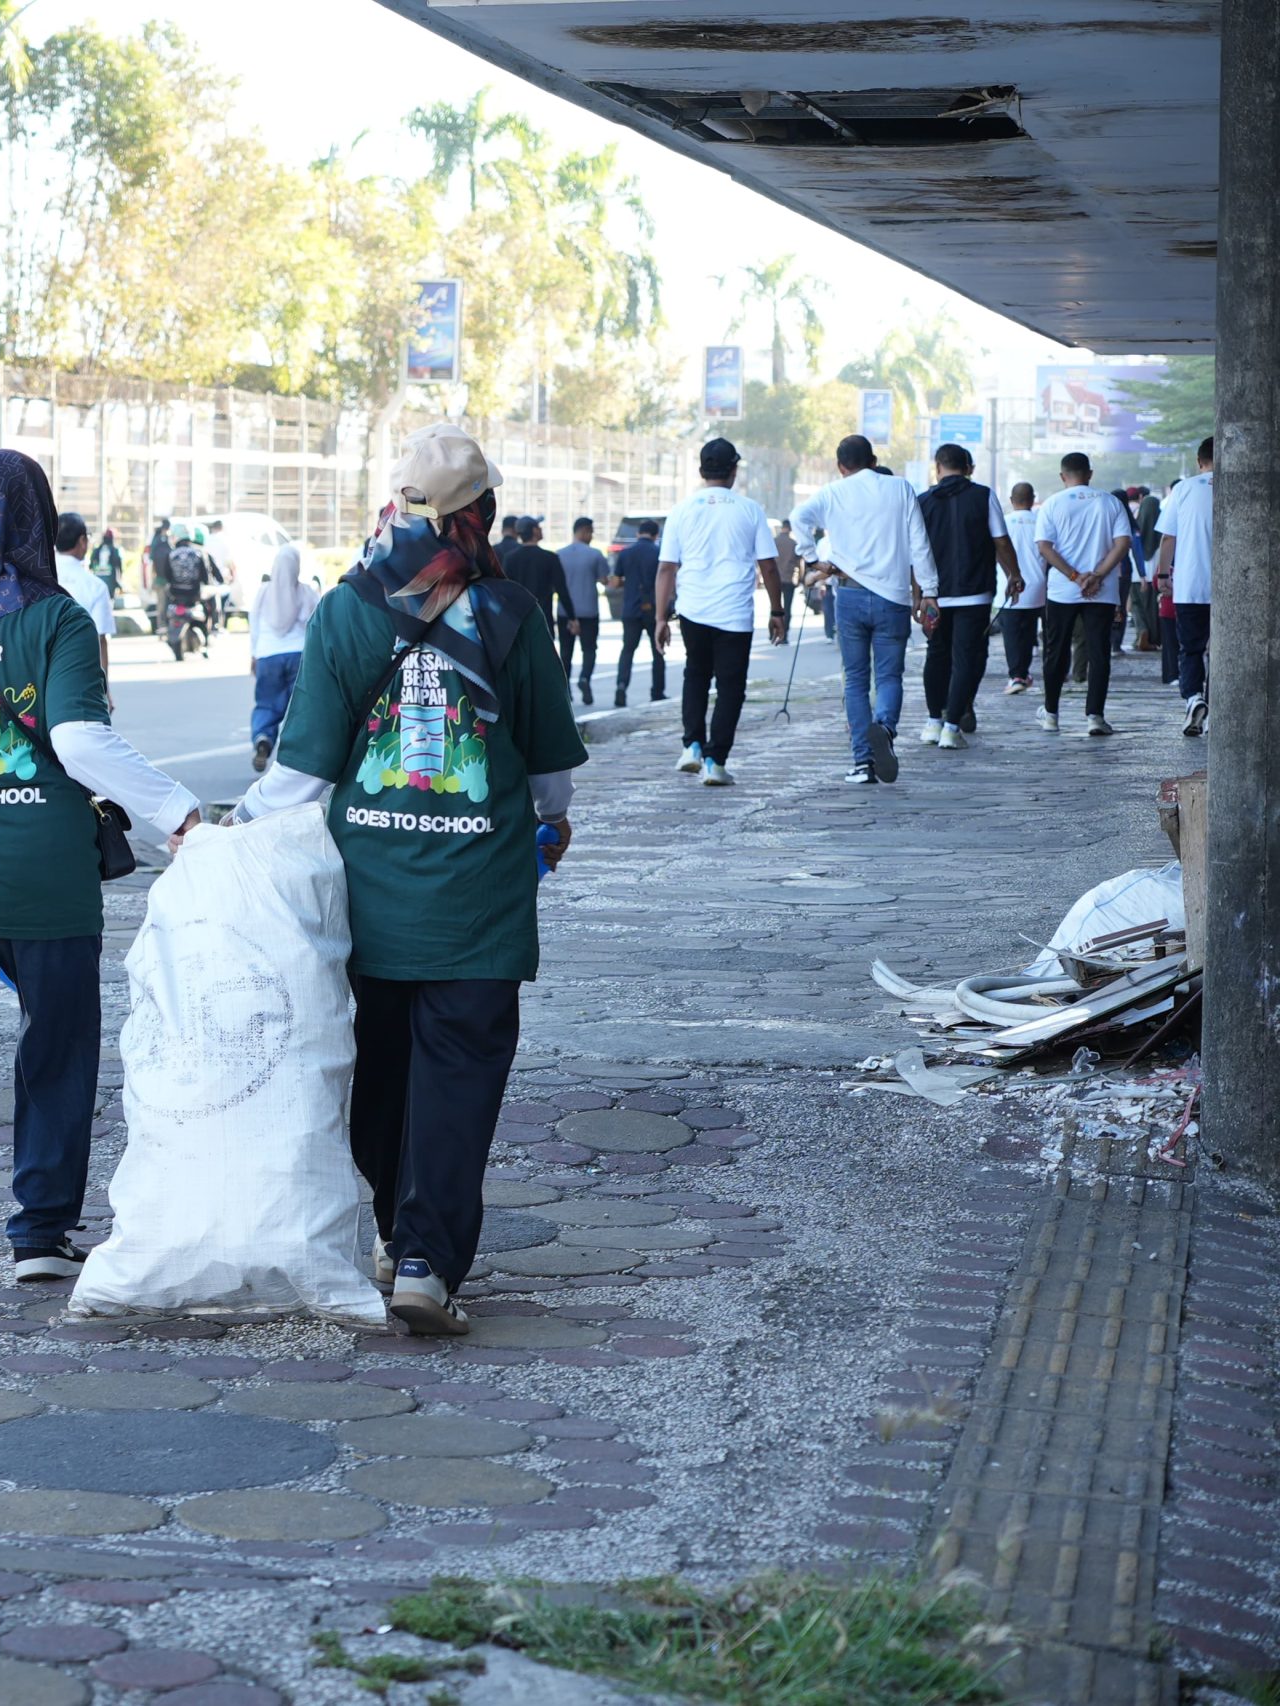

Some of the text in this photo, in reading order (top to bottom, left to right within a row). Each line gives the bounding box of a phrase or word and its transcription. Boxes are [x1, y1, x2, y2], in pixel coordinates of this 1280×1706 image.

[346, 806, 495, 834] GOES TO SCHOOL
